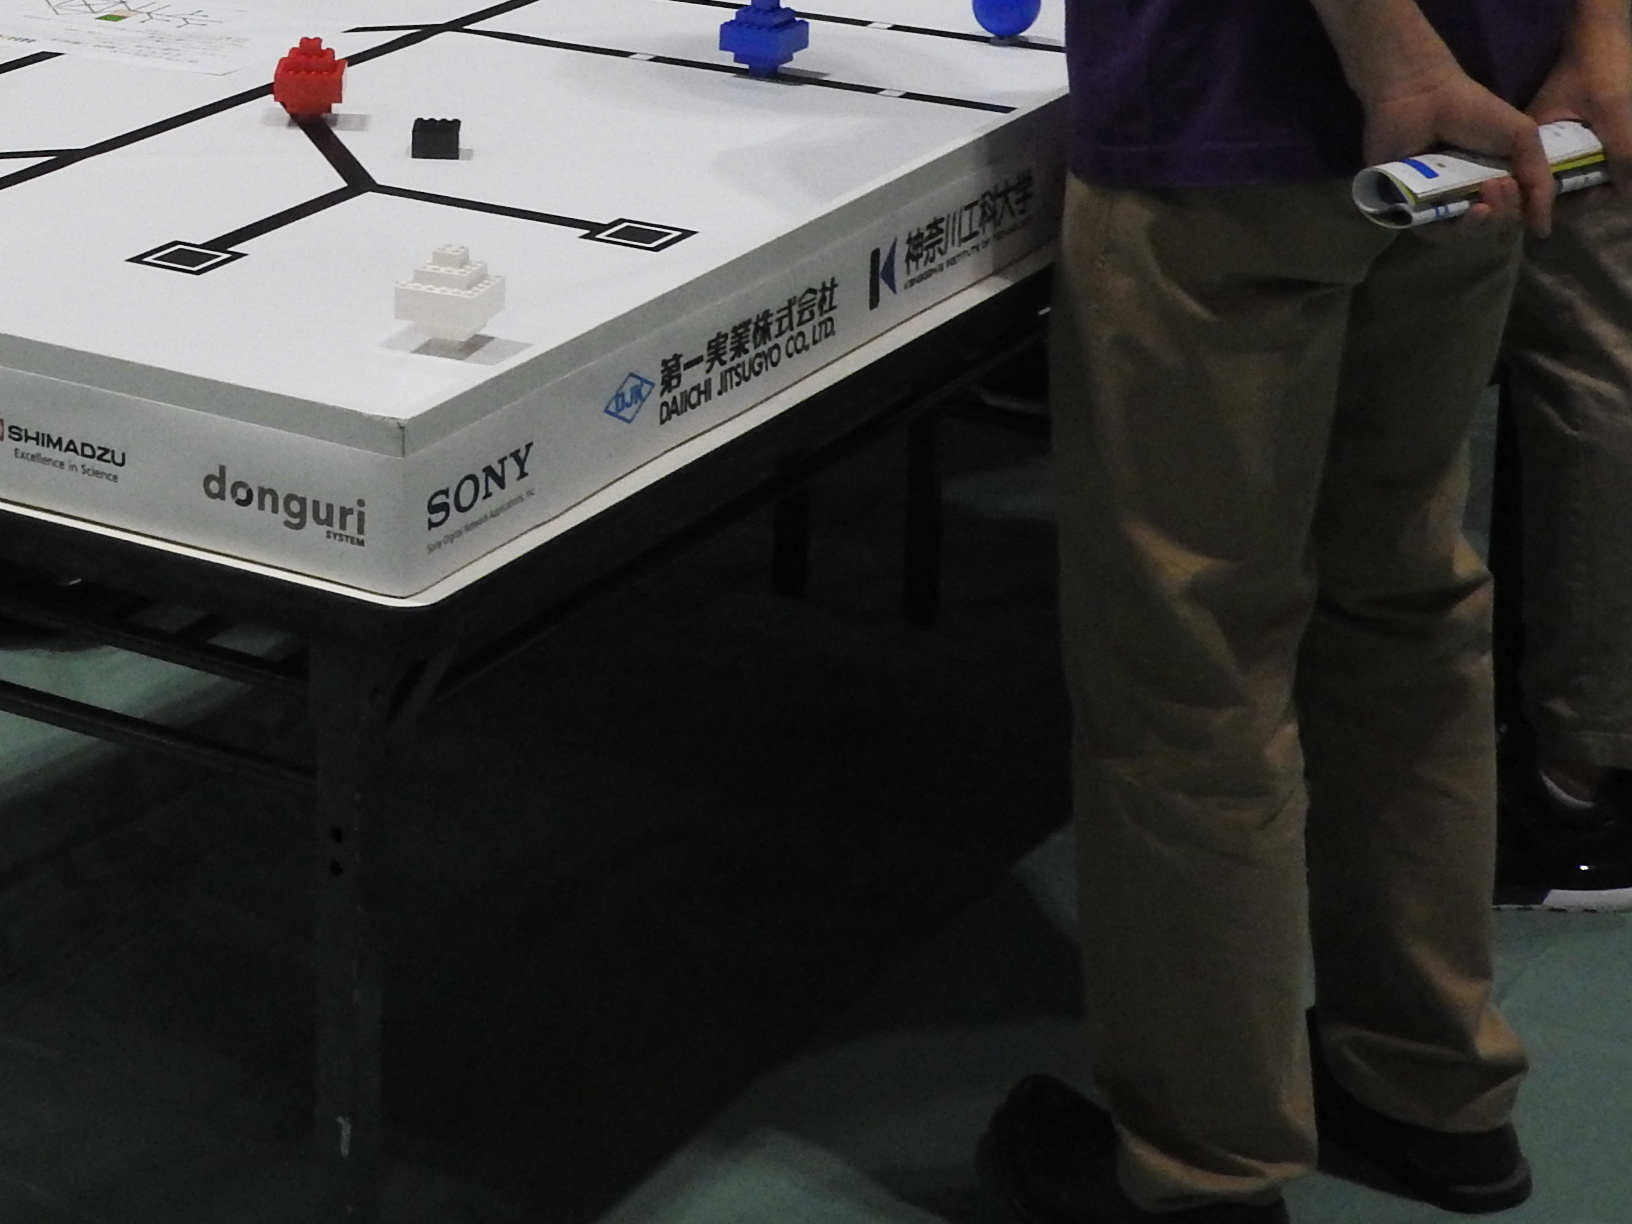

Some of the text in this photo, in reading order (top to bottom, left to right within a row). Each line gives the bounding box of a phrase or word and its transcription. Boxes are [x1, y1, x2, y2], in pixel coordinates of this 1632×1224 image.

[904, 168, 1034, 277] 神奈川工科大学
[659, 276, 839, 398] 第一実業株式会社
[659, 377, 712, 426] DAIICHI
[716, 342, 782, 397] JITSUGYO
[7, 424, 126, 468] SHIMADZU
[13, 447, 119, 484] Excellence in Science
[202, 463, 367, 537] donguri
[426, 440, 535, 532] SONY
[325, 529, 366, 548] SYSTEM
